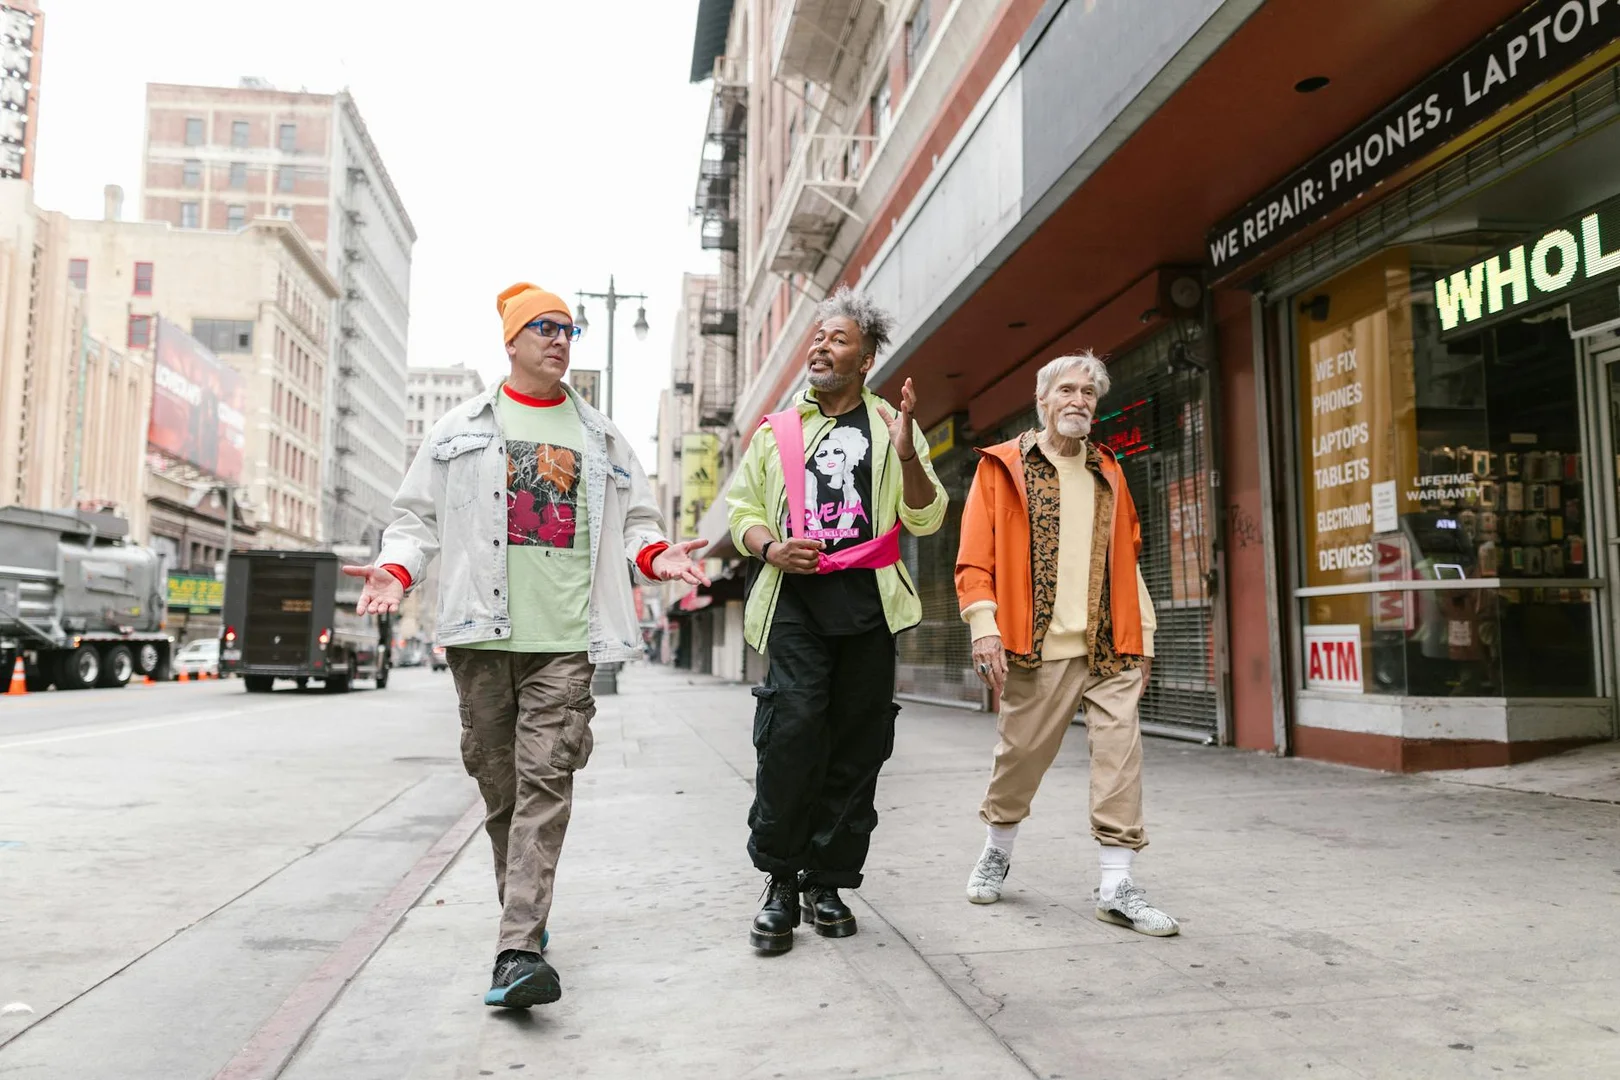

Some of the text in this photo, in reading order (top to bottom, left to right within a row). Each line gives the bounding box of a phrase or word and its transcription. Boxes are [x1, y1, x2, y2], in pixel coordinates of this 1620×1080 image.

[1209, 0, 1620, 268] WE REPAIR: PHONES, LAPTOP
[1435, 212, 1620, 331] WHOL
[1315, 347, 1358, 383] WE FIX
[1312, 382, 1364, 417] PHONES
[1312, 421, 1369, 458] LAPTOPS
[1314, 457, 1370, 491] TABLETS
[1413, 473, 1475, 488] LIFETIME
[1405, 487, 1483, 502] WARRANTY
[1317, 501, 1372, 533] ELECTRONIC
[1436, 519, 1456, 529] ATM
[1319, 542, 1374, 572] DEVICES
[1308, 641, 1359, 681] ATM
